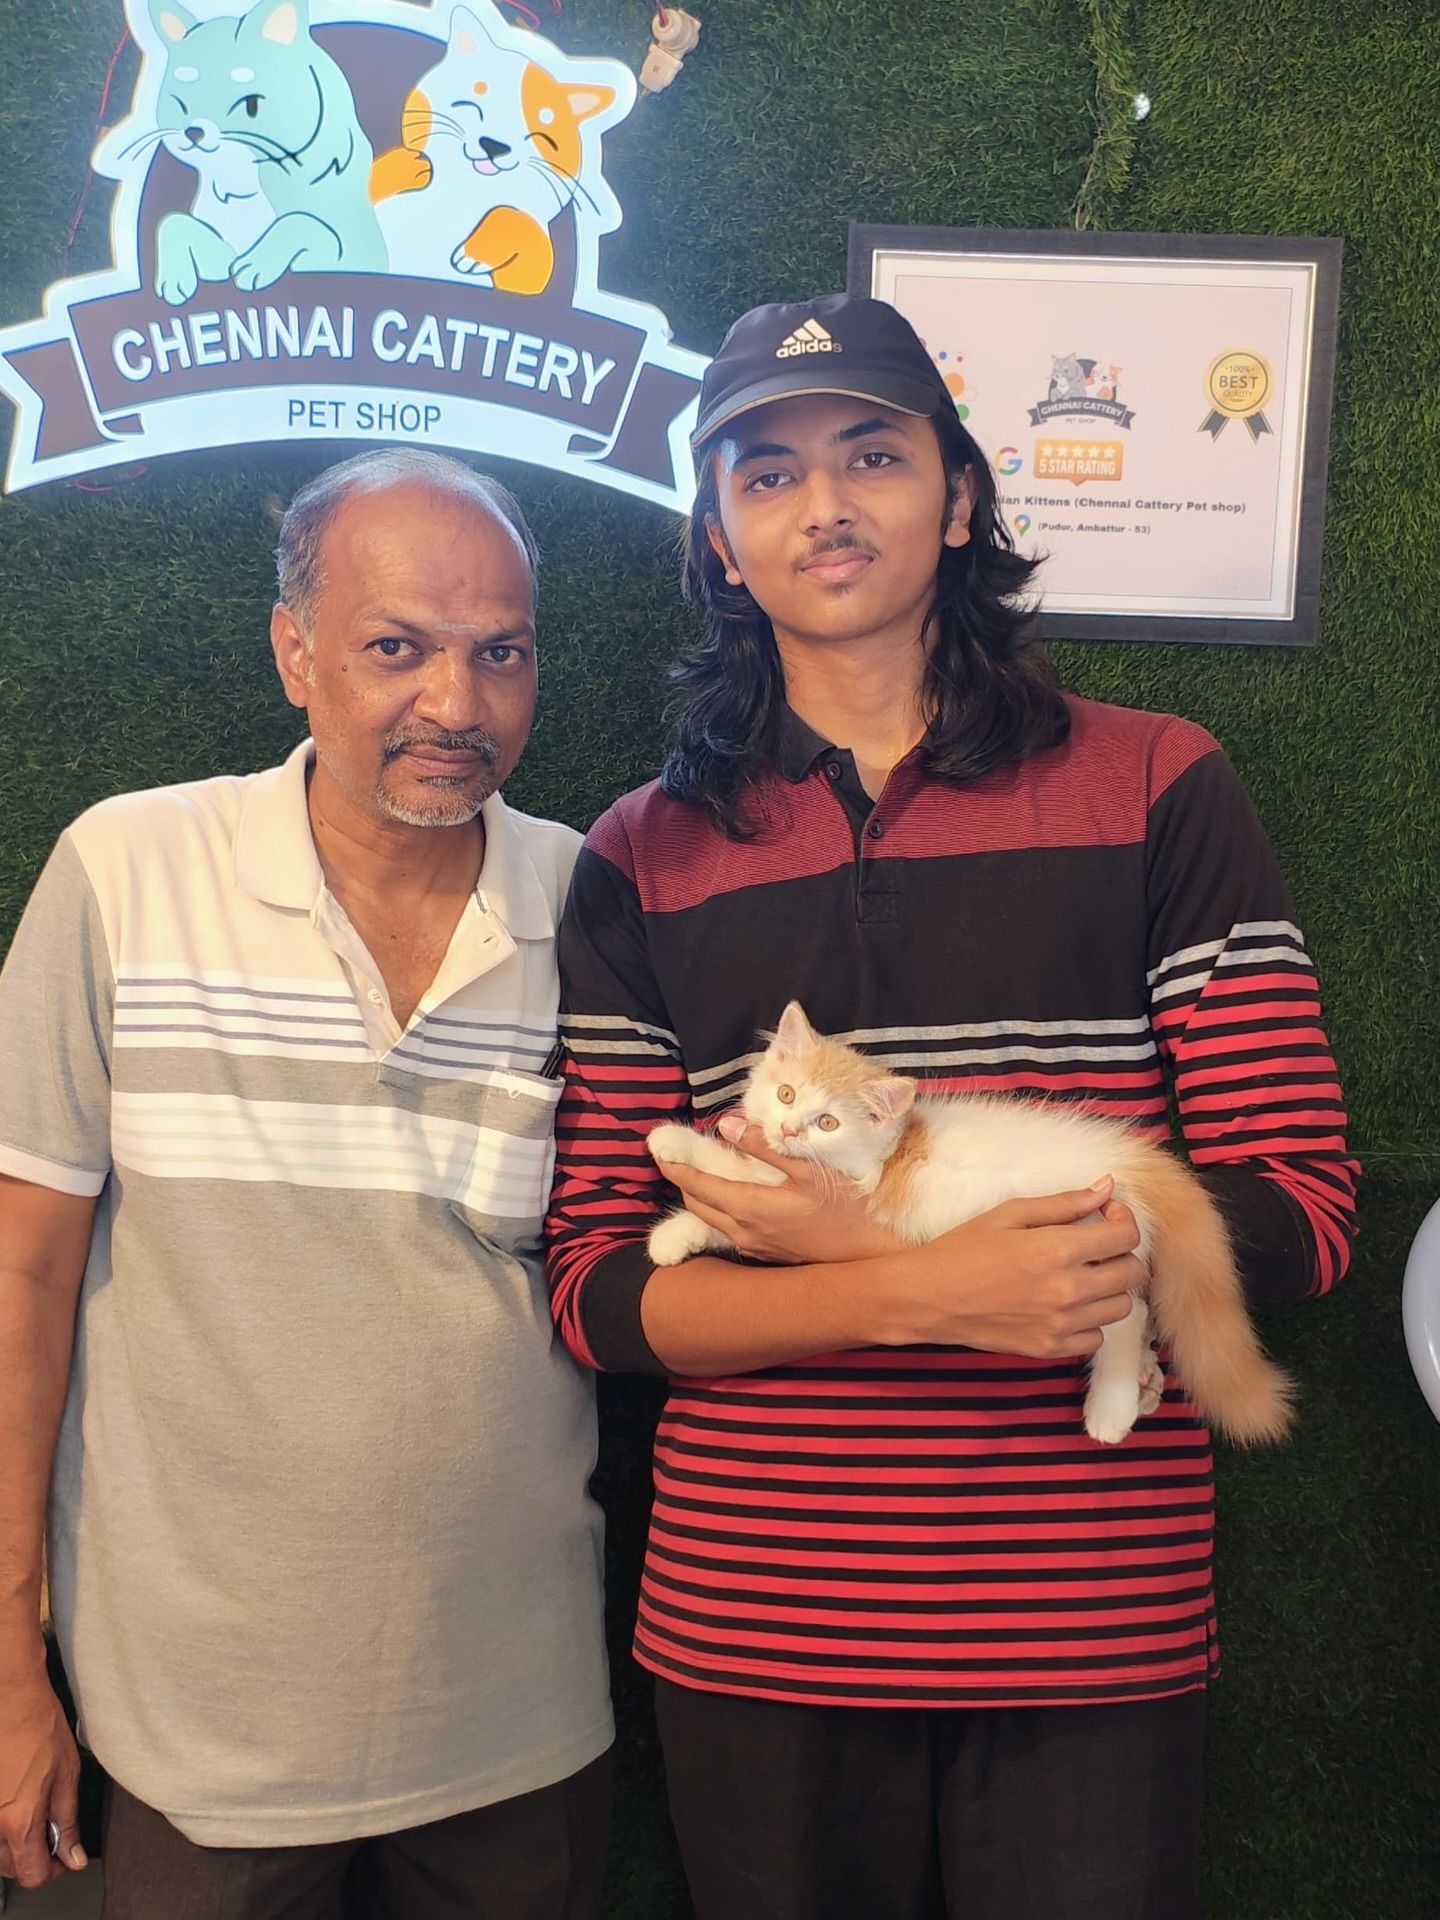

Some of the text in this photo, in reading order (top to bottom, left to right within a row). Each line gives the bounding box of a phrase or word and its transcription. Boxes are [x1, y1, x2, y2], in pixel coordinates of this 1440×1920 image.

[112, 305, 616, 406] CHENNAI CATTERY
[776, 339, 843, 358] adidas
[1219, 375, 1259, 389] BEST
[288, 399, 442, 433] PET SHOP
[1040, 401, 1123, 417] CHENNAI CATTERY
[1039, 459, 1116, 476] 5 STAR RATING
[1025, 496, 1070, 507] Kittens
[1074, 497, 1132, 510] (Chennai
[1135, 499, 1182, 513] Cattery
[1187, 501, 1207, 512] Pet
[1211, 502, 1246, 514] shop)
[1038, 523, 1074, 533] (Pudur,
[1077, 523, 1125, 533] Ambattur
[1135, 525, 1151, 534] 53)
